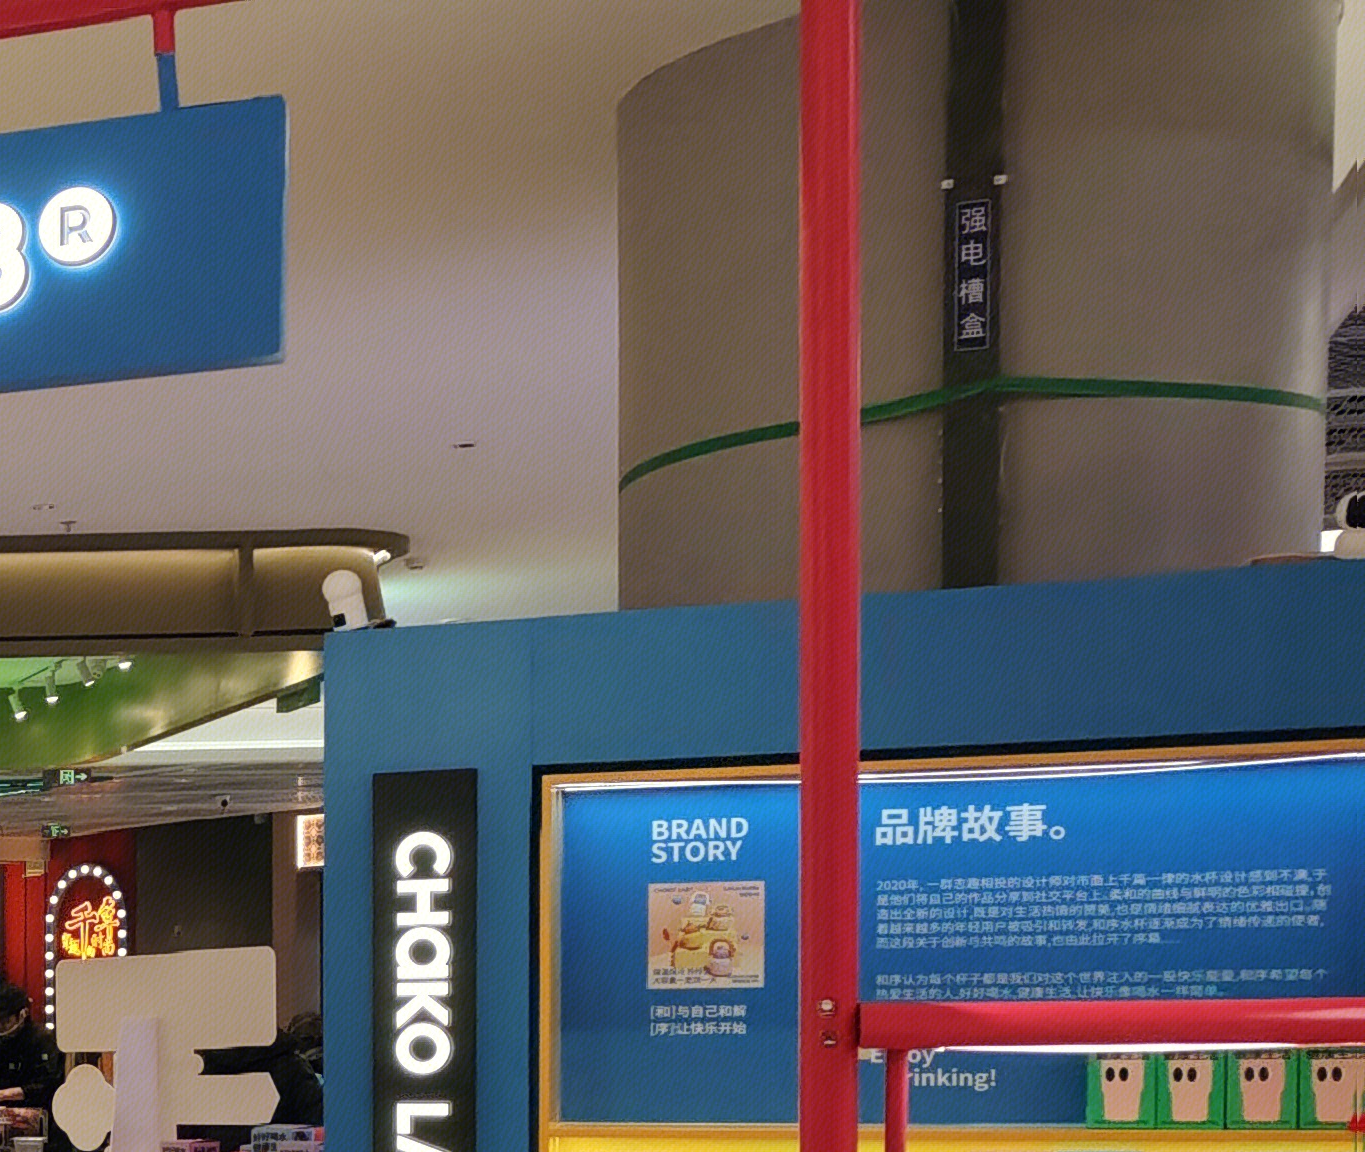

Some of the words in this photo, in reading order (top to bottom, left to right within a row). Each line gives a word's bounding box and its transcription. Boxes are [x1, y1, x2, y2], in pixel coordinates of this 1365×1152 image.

[959, 206, 987, 339] 强电槽盒
[651, 817, 749, 841] BRAND
[875, 802, 1066, 846] 品牌故事。
[650, 840, 743, 864] STORY
[870, 1047, 936, 1068] Eoy
